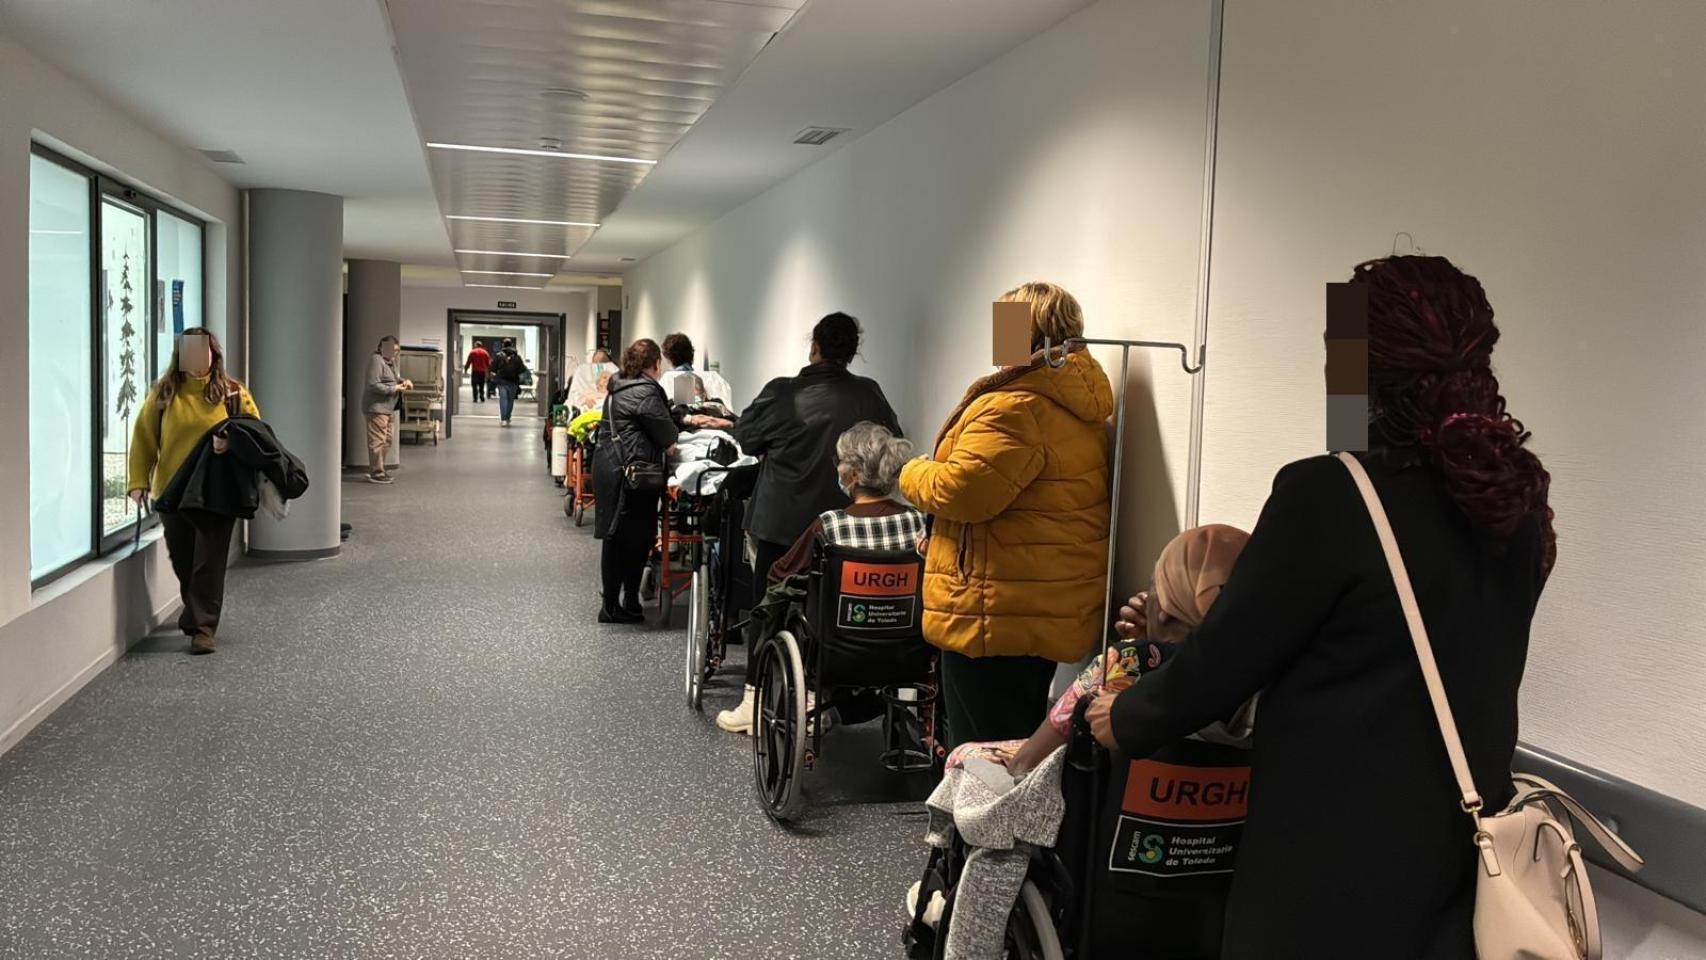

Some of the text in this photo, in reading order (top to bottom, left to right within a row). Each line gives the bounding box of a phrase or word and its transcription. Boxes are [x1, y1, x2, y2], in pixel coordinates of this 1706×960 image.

[854, 572, 908, 587] URGH
[1150, 776, 1248, 806] URGH
[1127, 830, 1142, 862] sescam
[1171, 836, 1216, 847] Hospital
[1165, 857, 1217, 866] de Toledo
